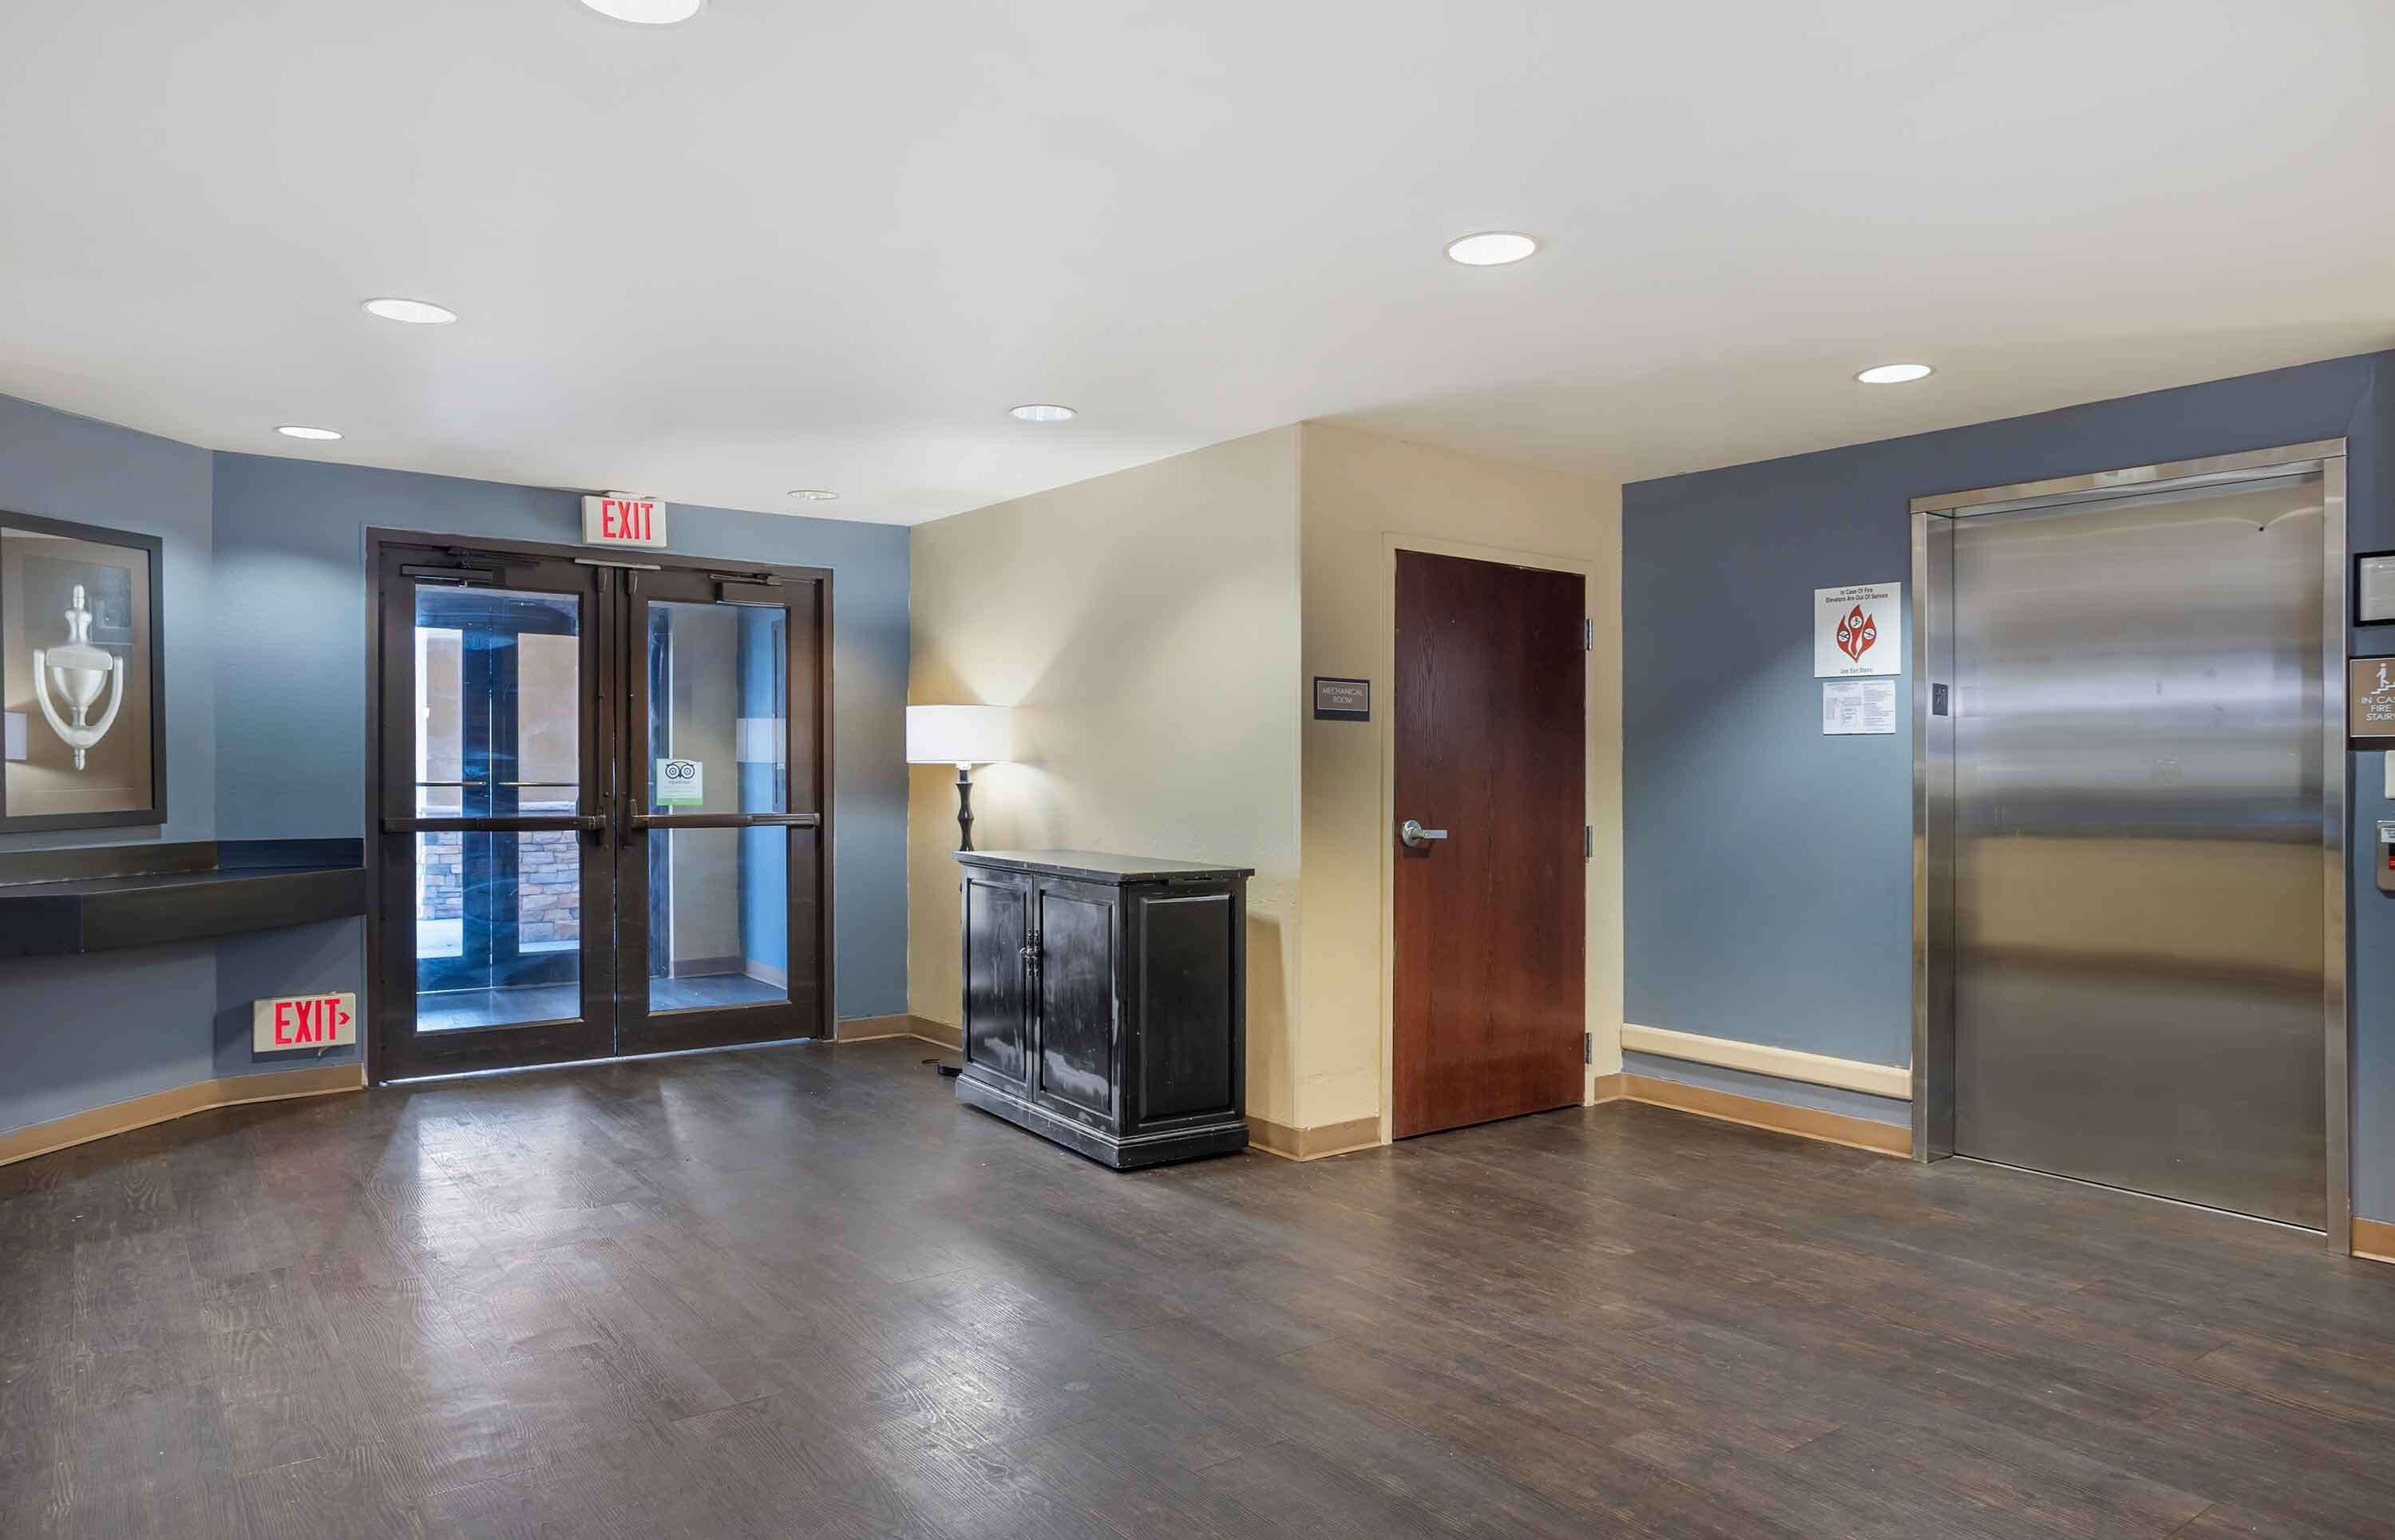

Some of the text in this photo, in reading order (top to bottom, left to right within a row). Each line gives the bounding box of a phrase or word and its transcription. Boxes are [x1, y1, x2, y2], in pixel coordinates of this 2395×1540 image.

[602, 500, 653, 540] EXIT
[1322, 687, 1362, 696] MECHANICAL
[275, 999, 340, 1045] EXIT
